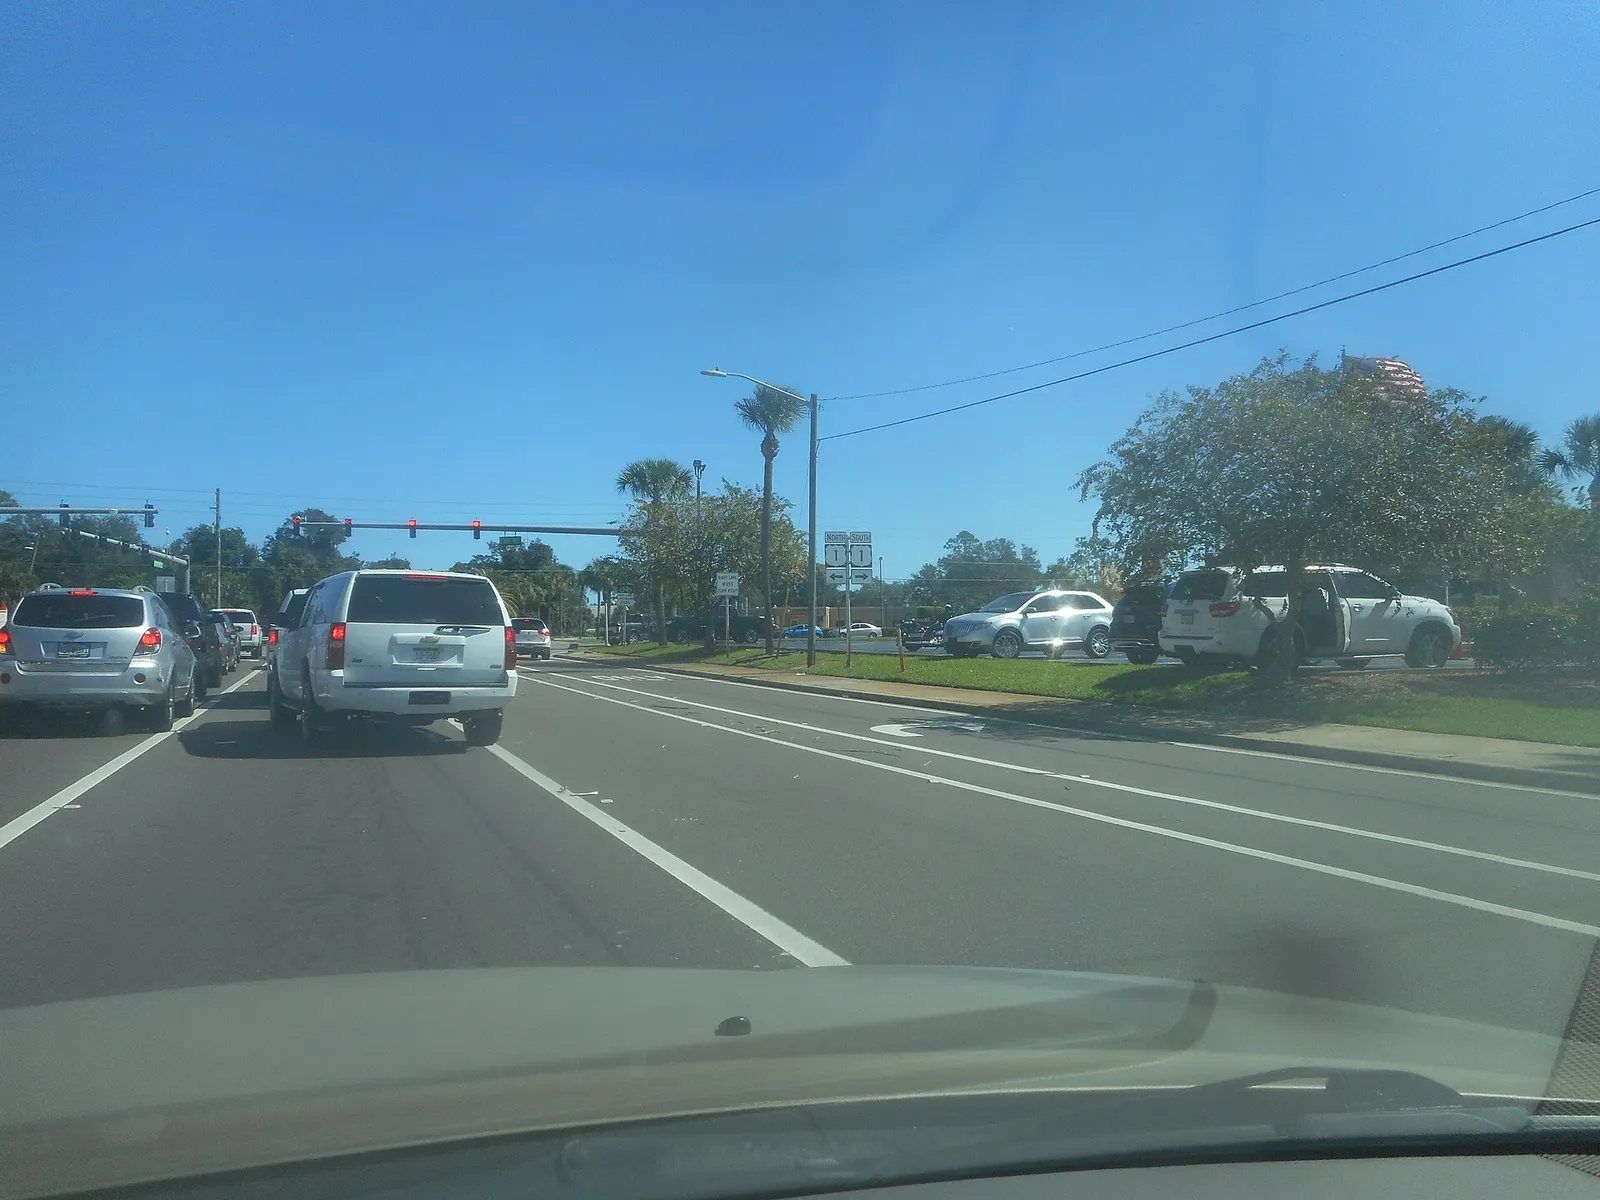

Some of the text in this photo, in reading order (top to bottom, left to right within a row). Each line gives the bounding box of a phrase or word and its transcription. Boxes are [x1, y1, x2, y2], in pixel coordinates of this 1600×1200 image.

[826, 533, 846, 541] NORTH
[852, 533, 871, 541] SOUTH
[834, 549, 838, 561] 1
[859, 549, 863, 562] 1
